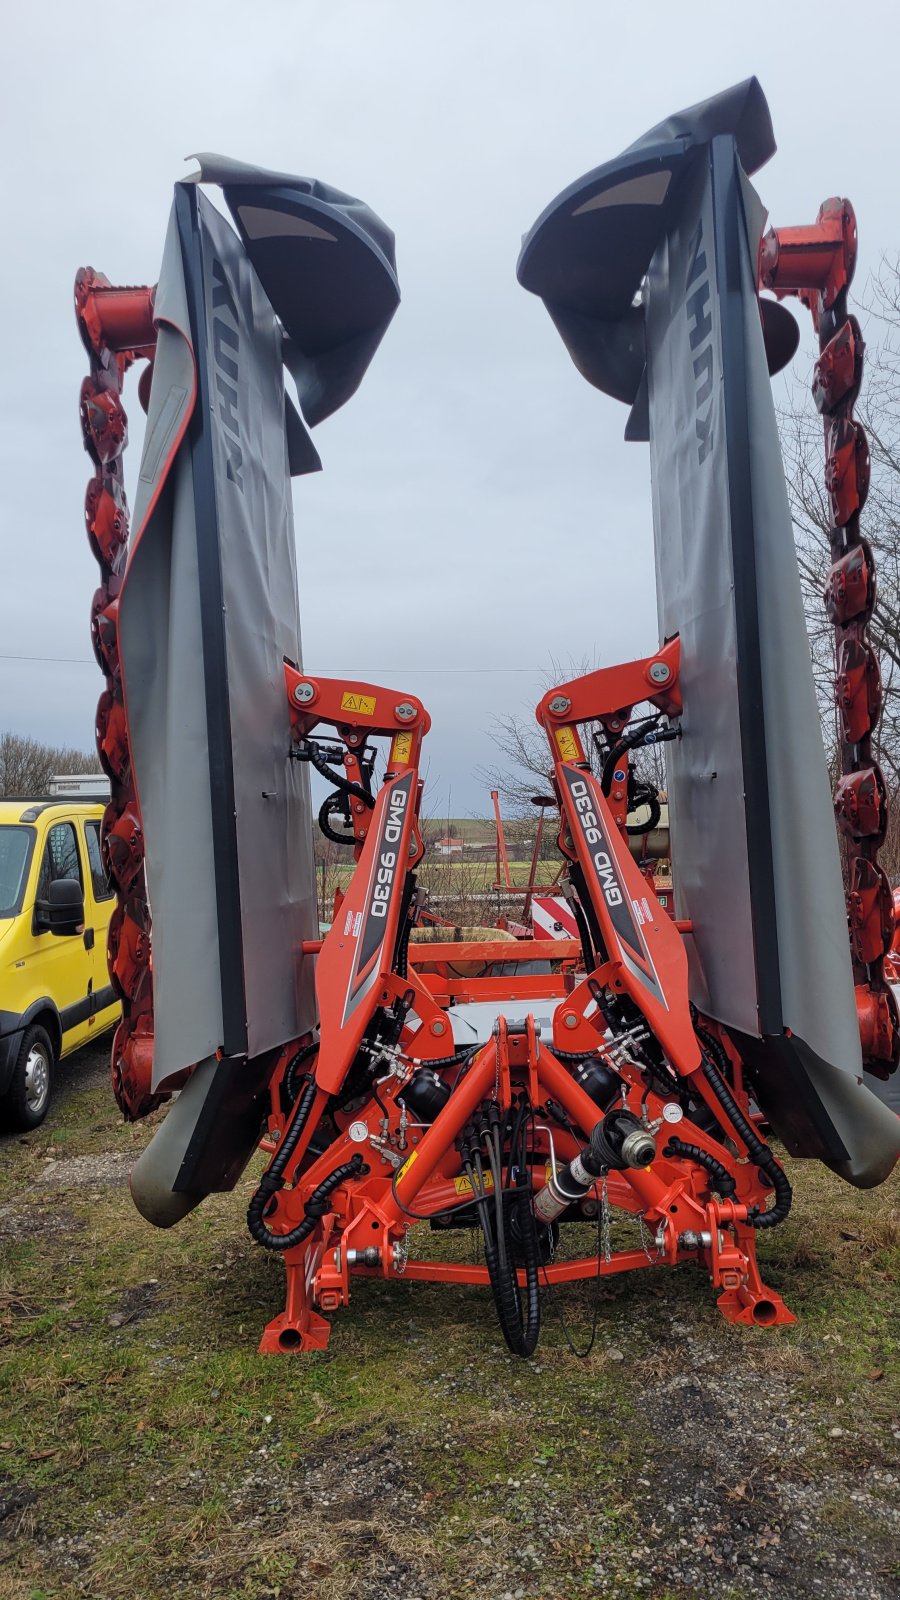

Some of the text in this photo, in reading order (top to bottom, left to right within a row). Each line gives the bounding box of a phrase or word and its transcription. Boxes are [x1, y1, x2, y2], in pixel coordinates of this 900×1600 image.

[211, 257, 244, 495] KUHN
[685, 218, 714, 466] KUHN
[371, 789, 407, 918] GMD 9530
[570, 780, 623, 907] GMD 9530
